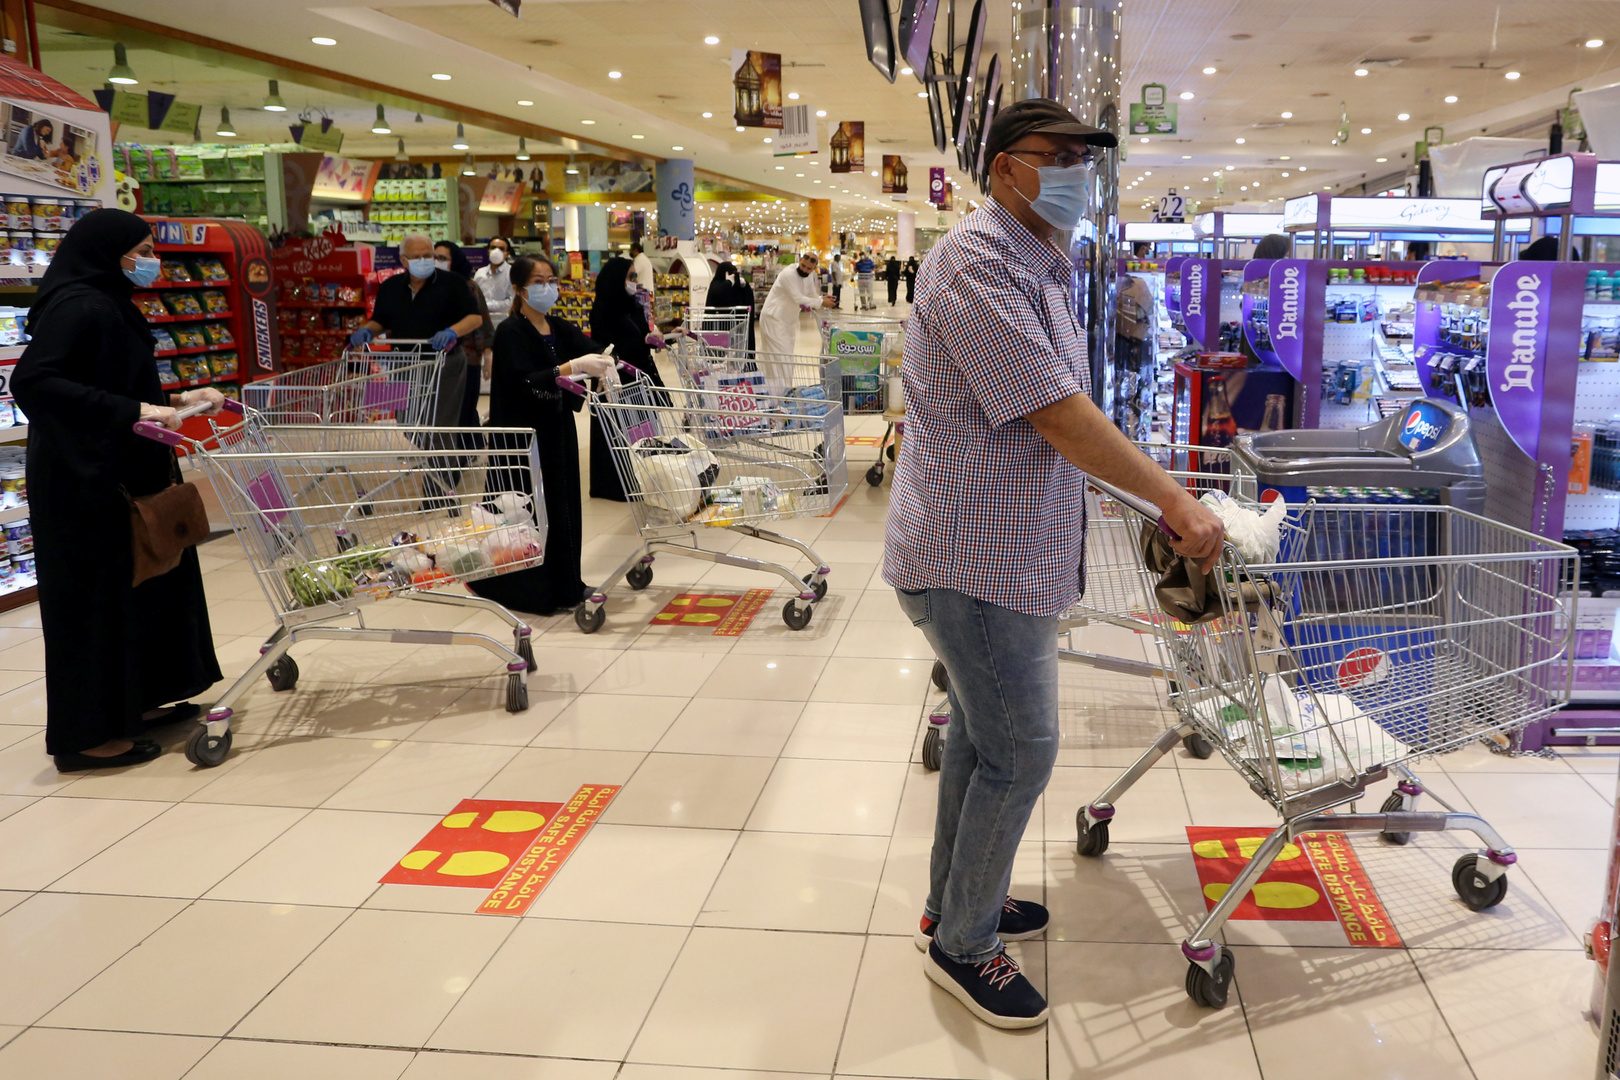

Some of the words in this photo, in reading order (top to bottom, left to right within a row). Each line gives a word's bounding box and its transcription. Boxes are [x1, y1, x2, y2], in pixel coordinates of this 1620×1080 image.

[1186, 264, 1203, 317] Danube
[1276, 267, 1299, 340] Danube
[254, 300, 272, 368] SNICKERS
[1500, 274, 1541, 392] Danube
[1413, 420, 1443, 440] pepsi
[539, 815, 571, 843] SAFE
[567, 787, 595, 813] KEEP
[483, 846, 547, 909] DISTANCE
[1307, 841, 1333, 871] SAFE
[1323, 873, 1368, 942] DISTANCE
